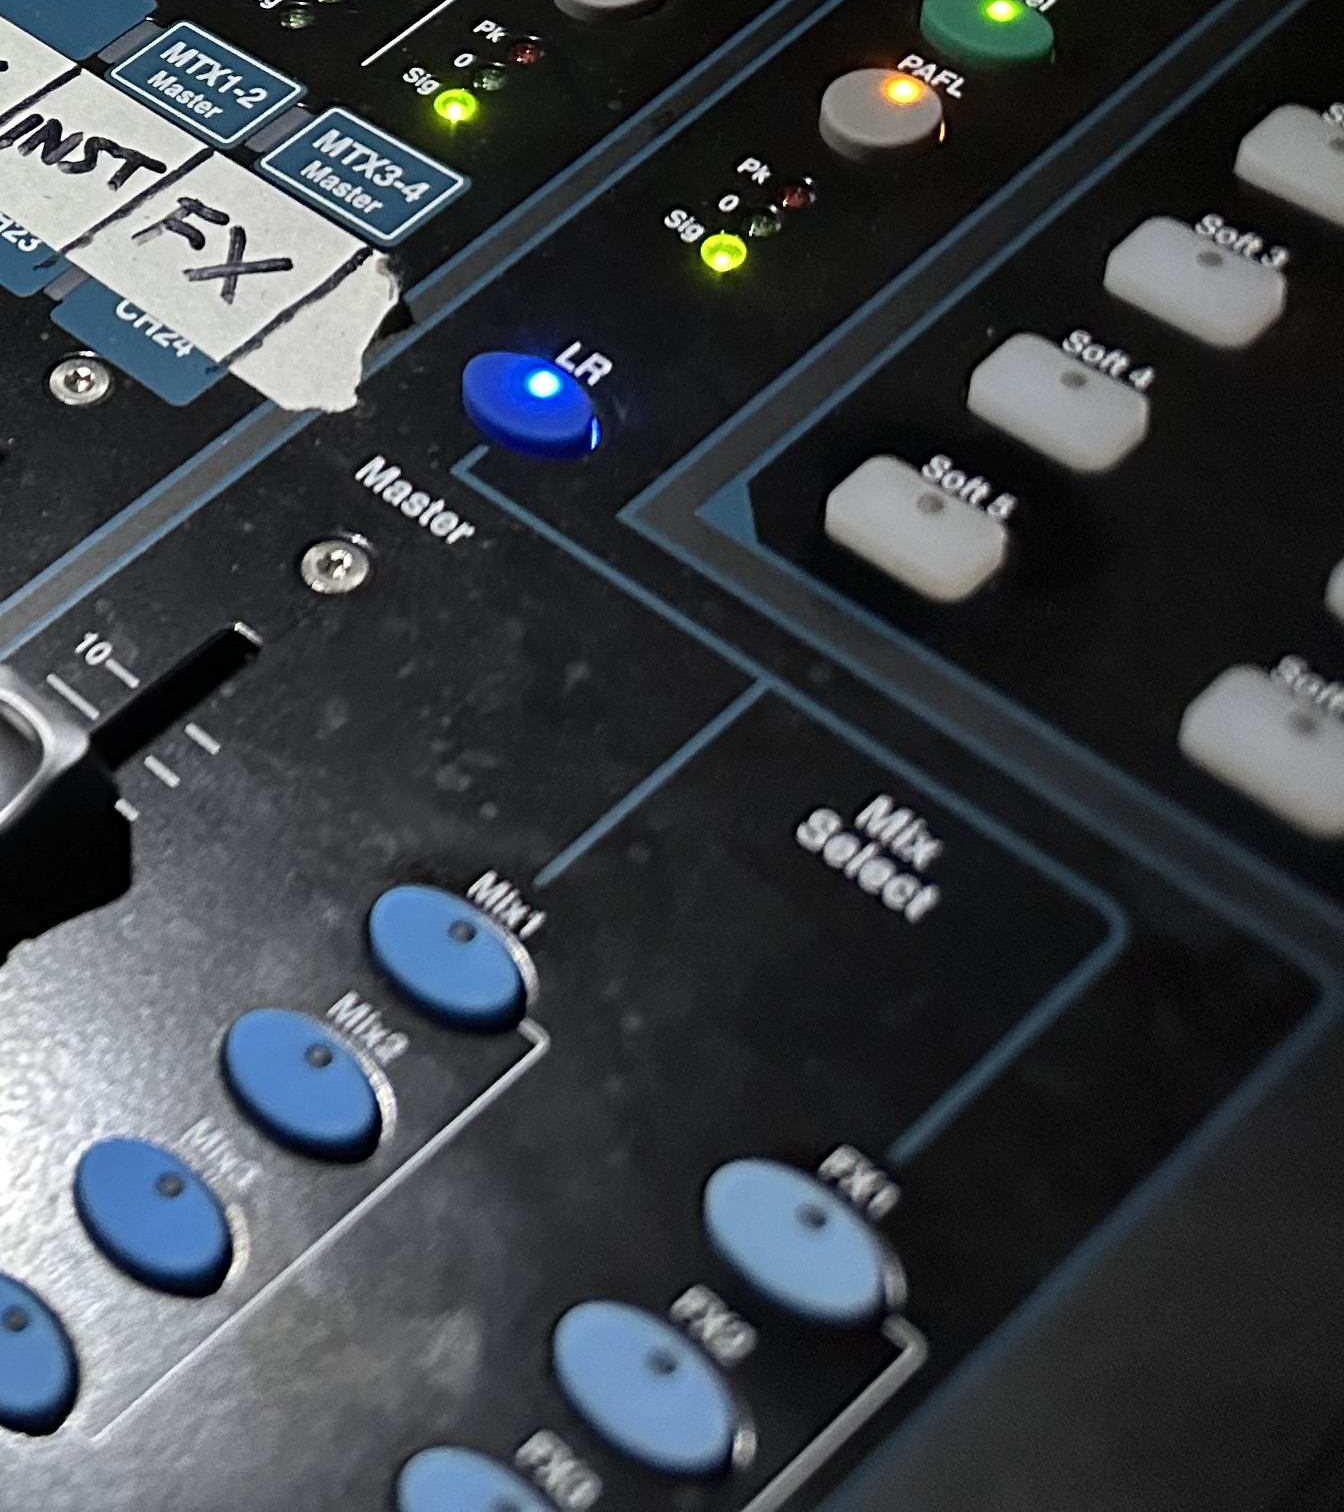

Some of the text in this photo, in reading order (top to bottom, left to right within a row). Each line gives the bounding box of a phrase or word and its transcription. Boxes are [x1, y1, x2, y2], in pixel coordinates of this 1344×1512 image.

[474, 19, 506, 43] Pk
[159, 41, 269, 110] MTX1-2
[403, 66, 440, 95] Sig
[454, 52, 474, 68] 0
[897, 53, 964, 99] PAFL
[147, 70, 225, 121] Master
[299, 160, 386, 215] Master
[311, 128, 432, 204] MTX3-4
[737, 157, 772, 185] Pk
[664, 208, 706, 244] Sig
[718, 194, 739, 213] 0
[131, 196, 295, 305] FX
[1194, 211, 1292, 271] Soft 3
[114, 295, 198, 361] CH24
[555, 340, 614, 387] LR
[1062, 328, 1158, 391] Soft 4
[353, 454, 477, 545] Master
[921, 455, 992, 507] Soft
[74, 631, 112, 667] 10
[854, 793, 944, 873] Mix
[795, 807, 943, 925] Select
[466, 869, 547, 940] Mix1
[326, 989, 411, 1064] Mix2
